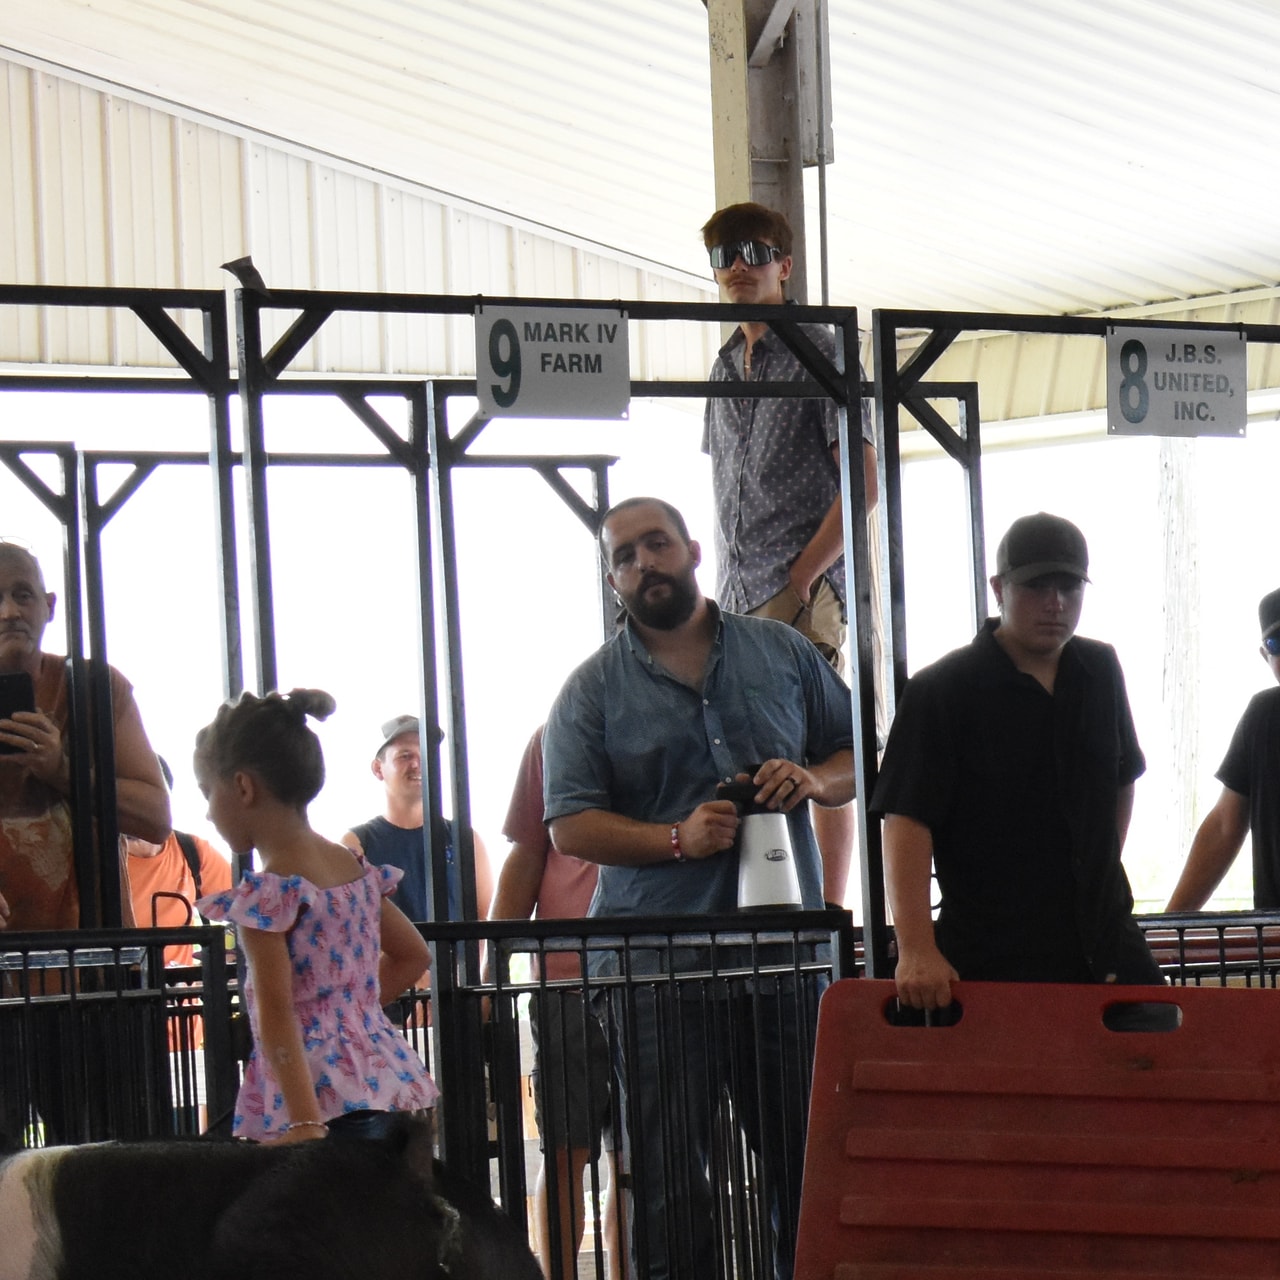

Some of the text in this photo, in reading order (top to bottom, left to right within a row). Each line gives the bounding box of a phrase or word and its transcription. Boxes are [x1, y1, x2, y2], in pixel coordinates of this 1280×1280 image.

[524, 322, 618, 343] MARK IV
[488, 318, 521, 408] 9
[541, 353, 602, 373] FARM
[1165, 343, 1222, 364] J.B.S.
[1119, 338, 1149, 424] 8
[1153, 371, 1234, 397] UNITED,
[1174, 401, 1215, 421] INC.
